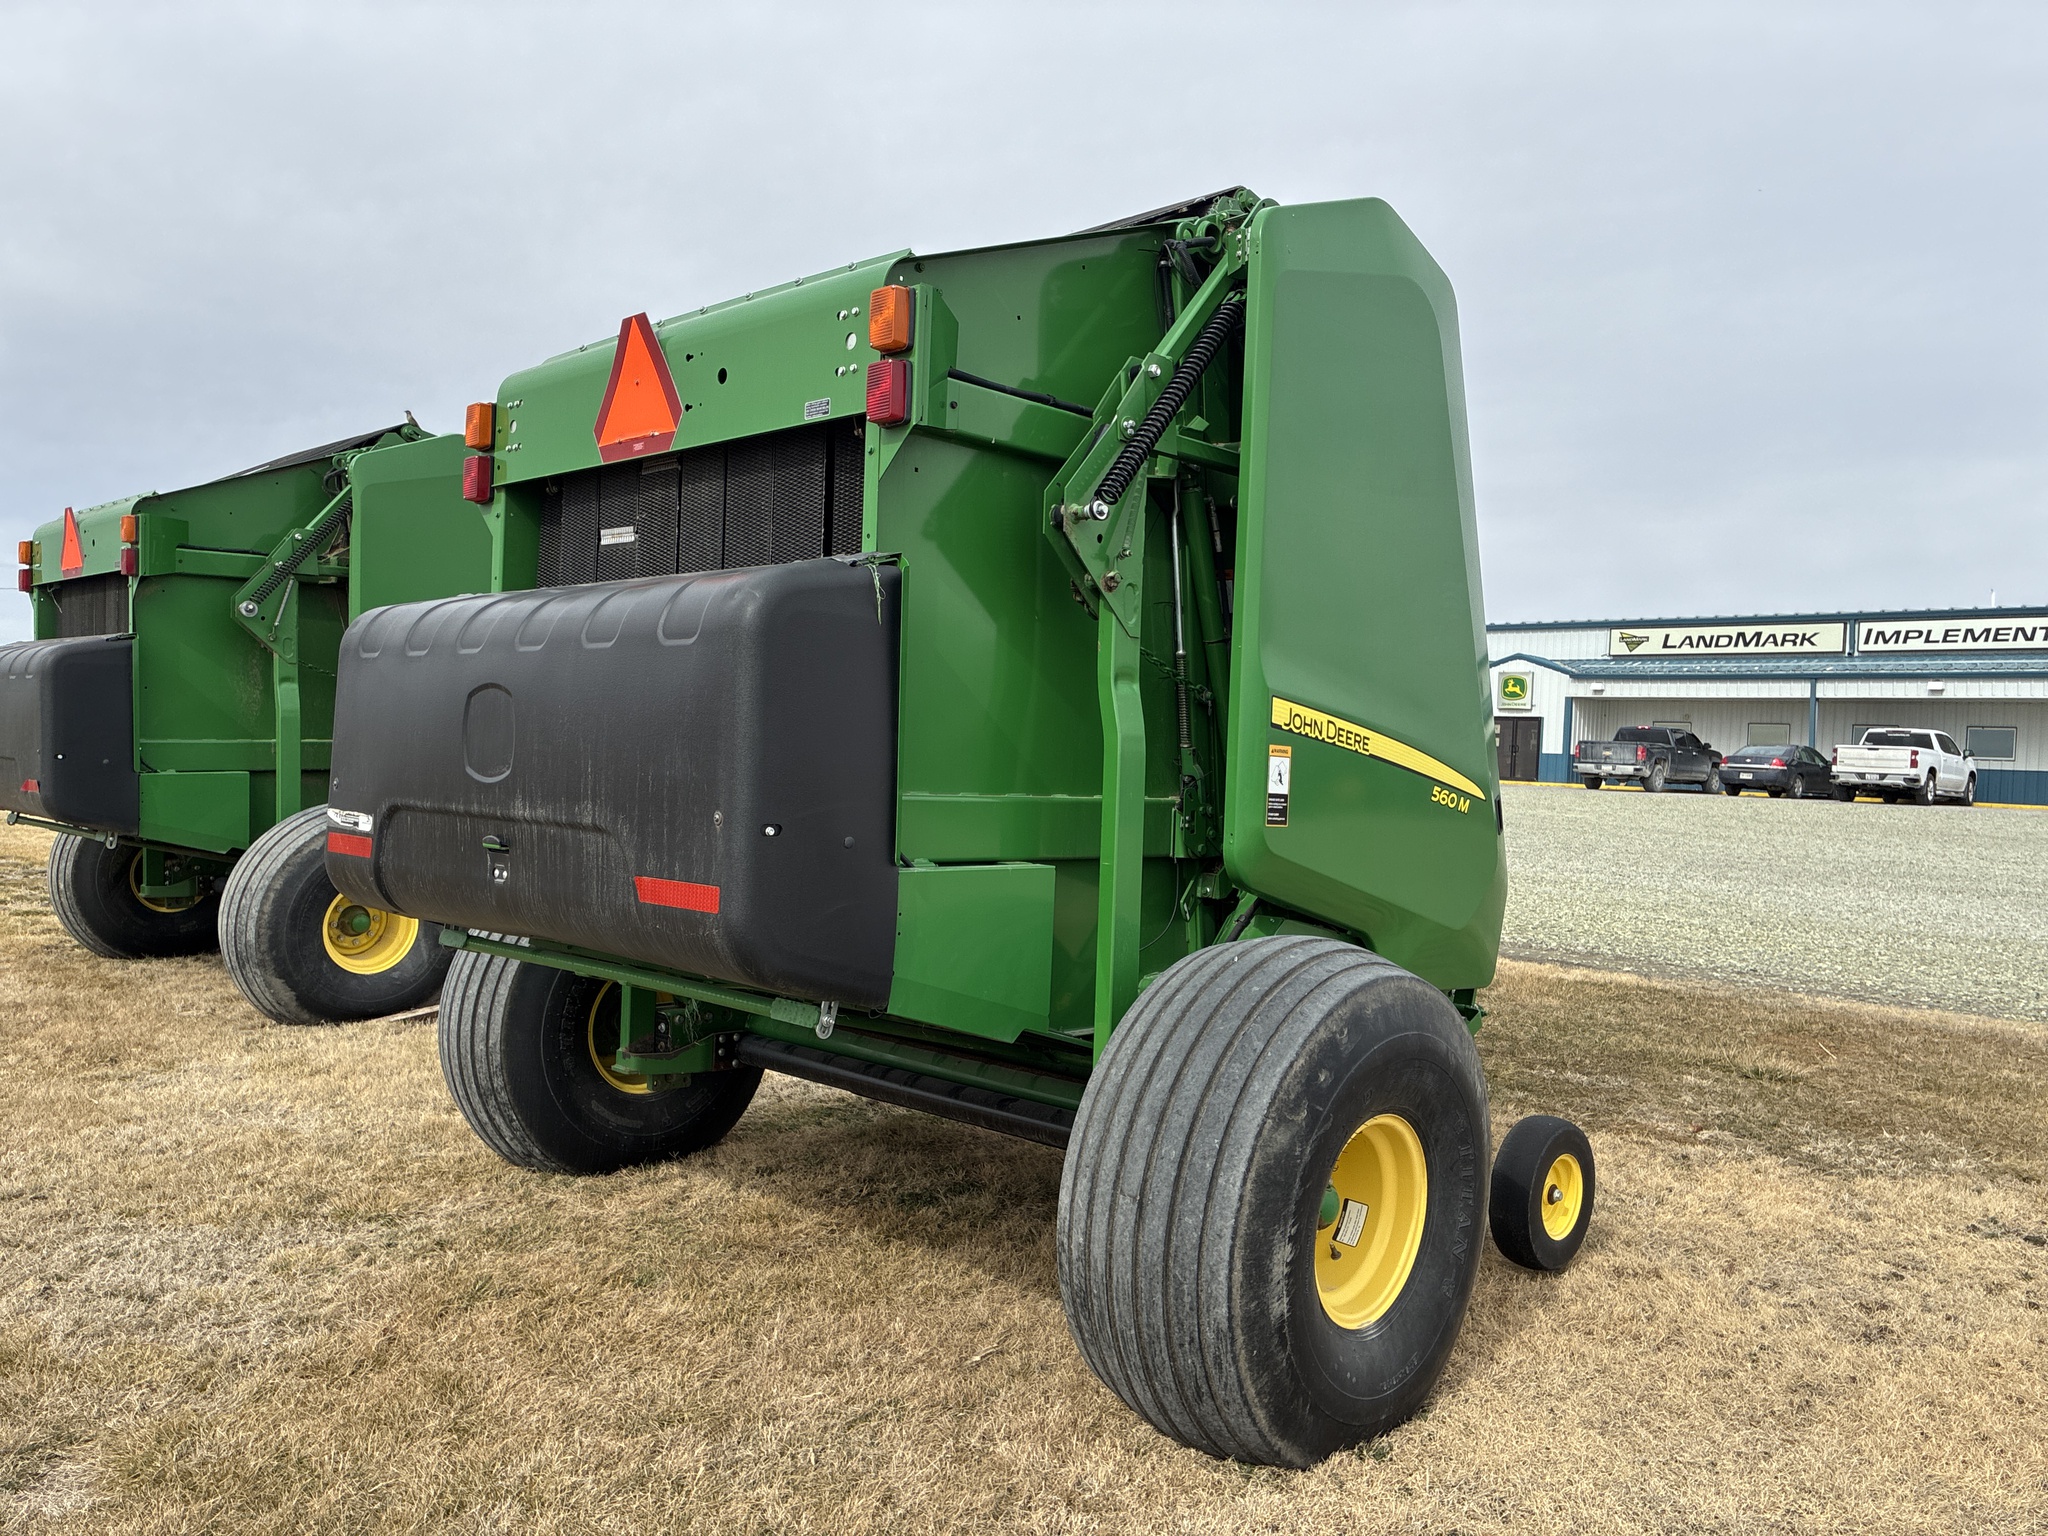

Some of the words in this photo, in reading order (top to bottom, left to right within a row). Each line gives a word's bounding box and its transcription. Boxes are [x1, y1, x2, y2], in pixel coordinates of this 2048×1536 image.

[1283, 707, 1323, 737] JOHN
[1326, 720, 1370, 752] DEERE
[1430, 785, 1458, 809] 560
[1457, 796, 1471, 815] M
